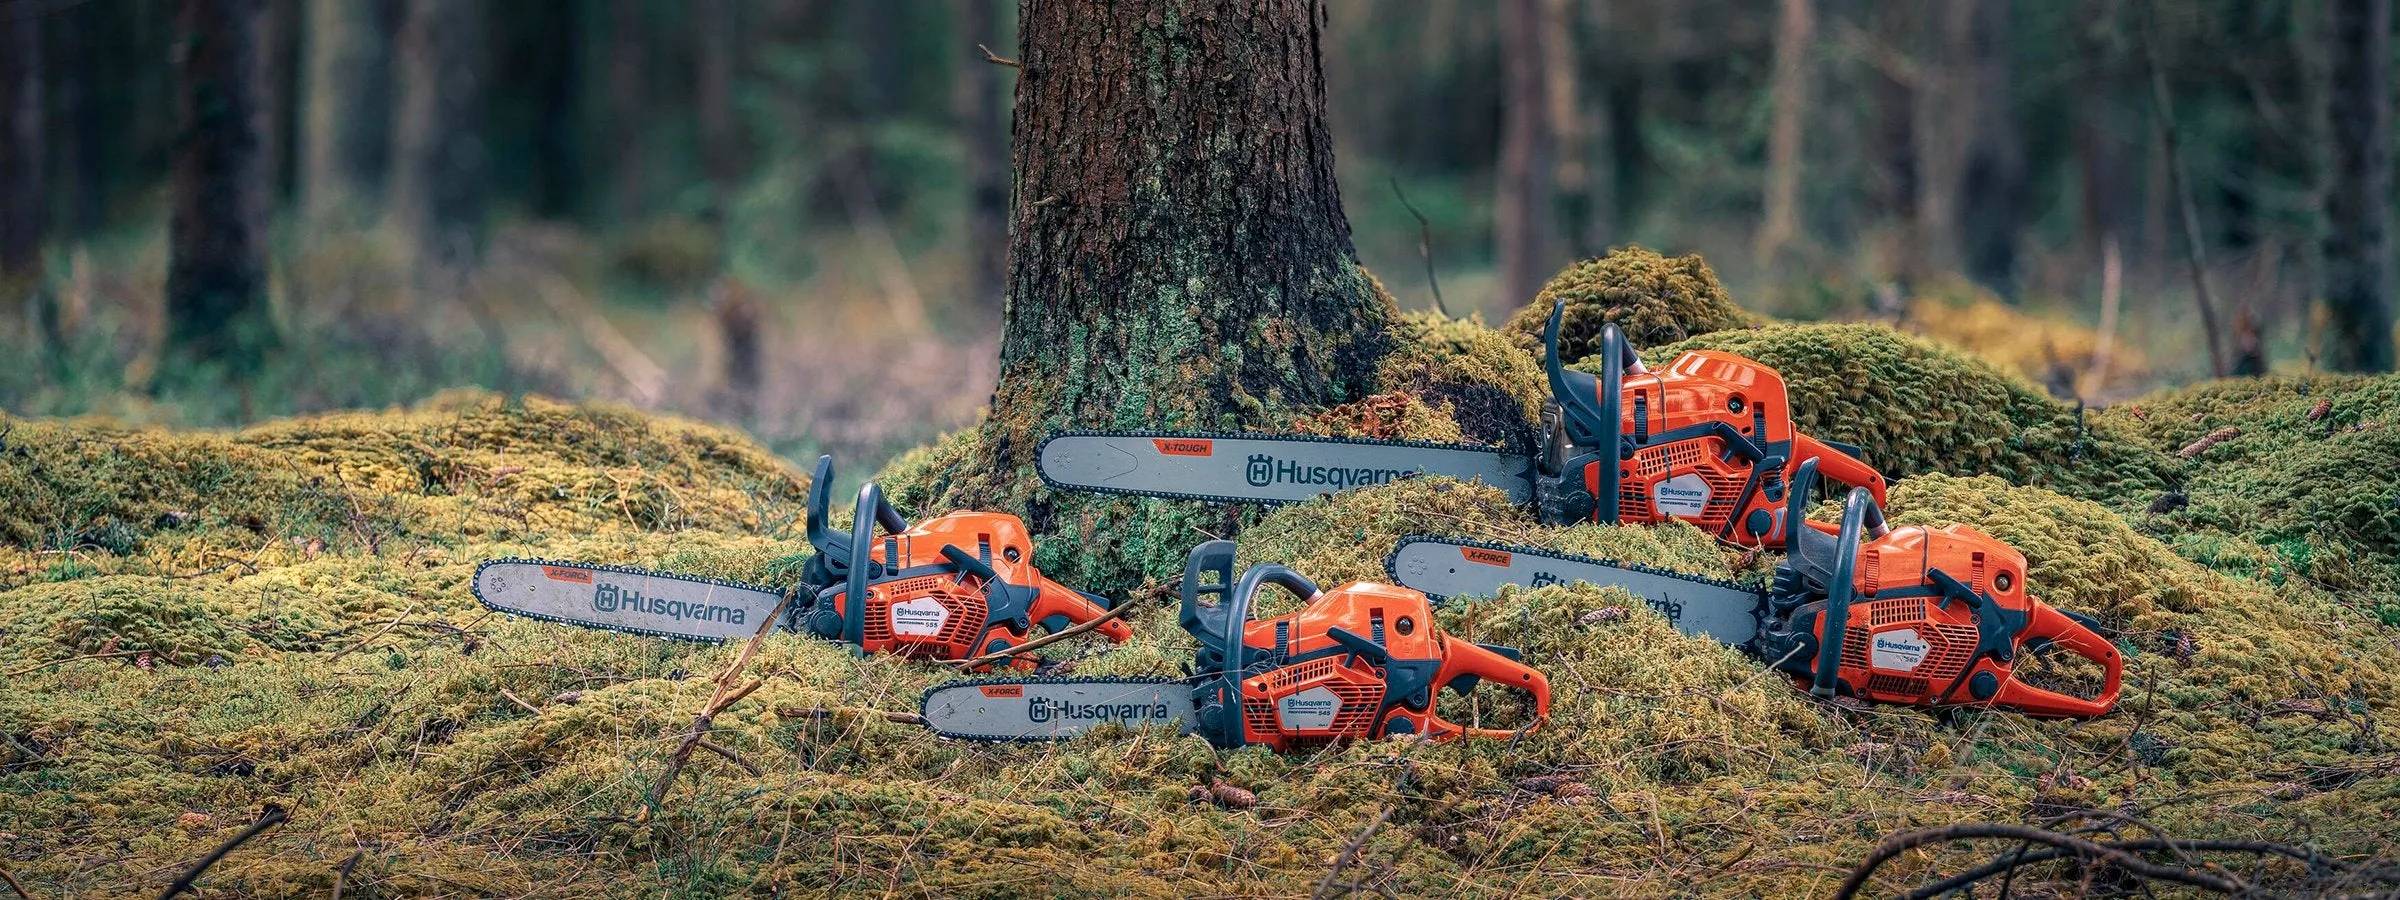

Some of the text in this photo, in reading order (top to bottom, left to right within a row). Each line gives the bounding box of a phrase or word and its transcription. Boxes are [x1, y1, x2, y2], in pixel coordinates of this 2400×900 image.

[1163, 442, 1207, 453] X-TOUGH
[1668, 488, 1703, 496] Husqvarna
[1469, 551, 1509, 564] X-FORCE
[621, 590, 745, 625] Husqvarna
[904, 609, 940, 617] Husqvarna
[1885, 641, 1920, 651] Husqvarna
[988, 688, 1020, 696] X-FORCE
[1295, 699, 1332, 707] Husqvarna
[1053, 700, 1168, 722] Husqvarna
